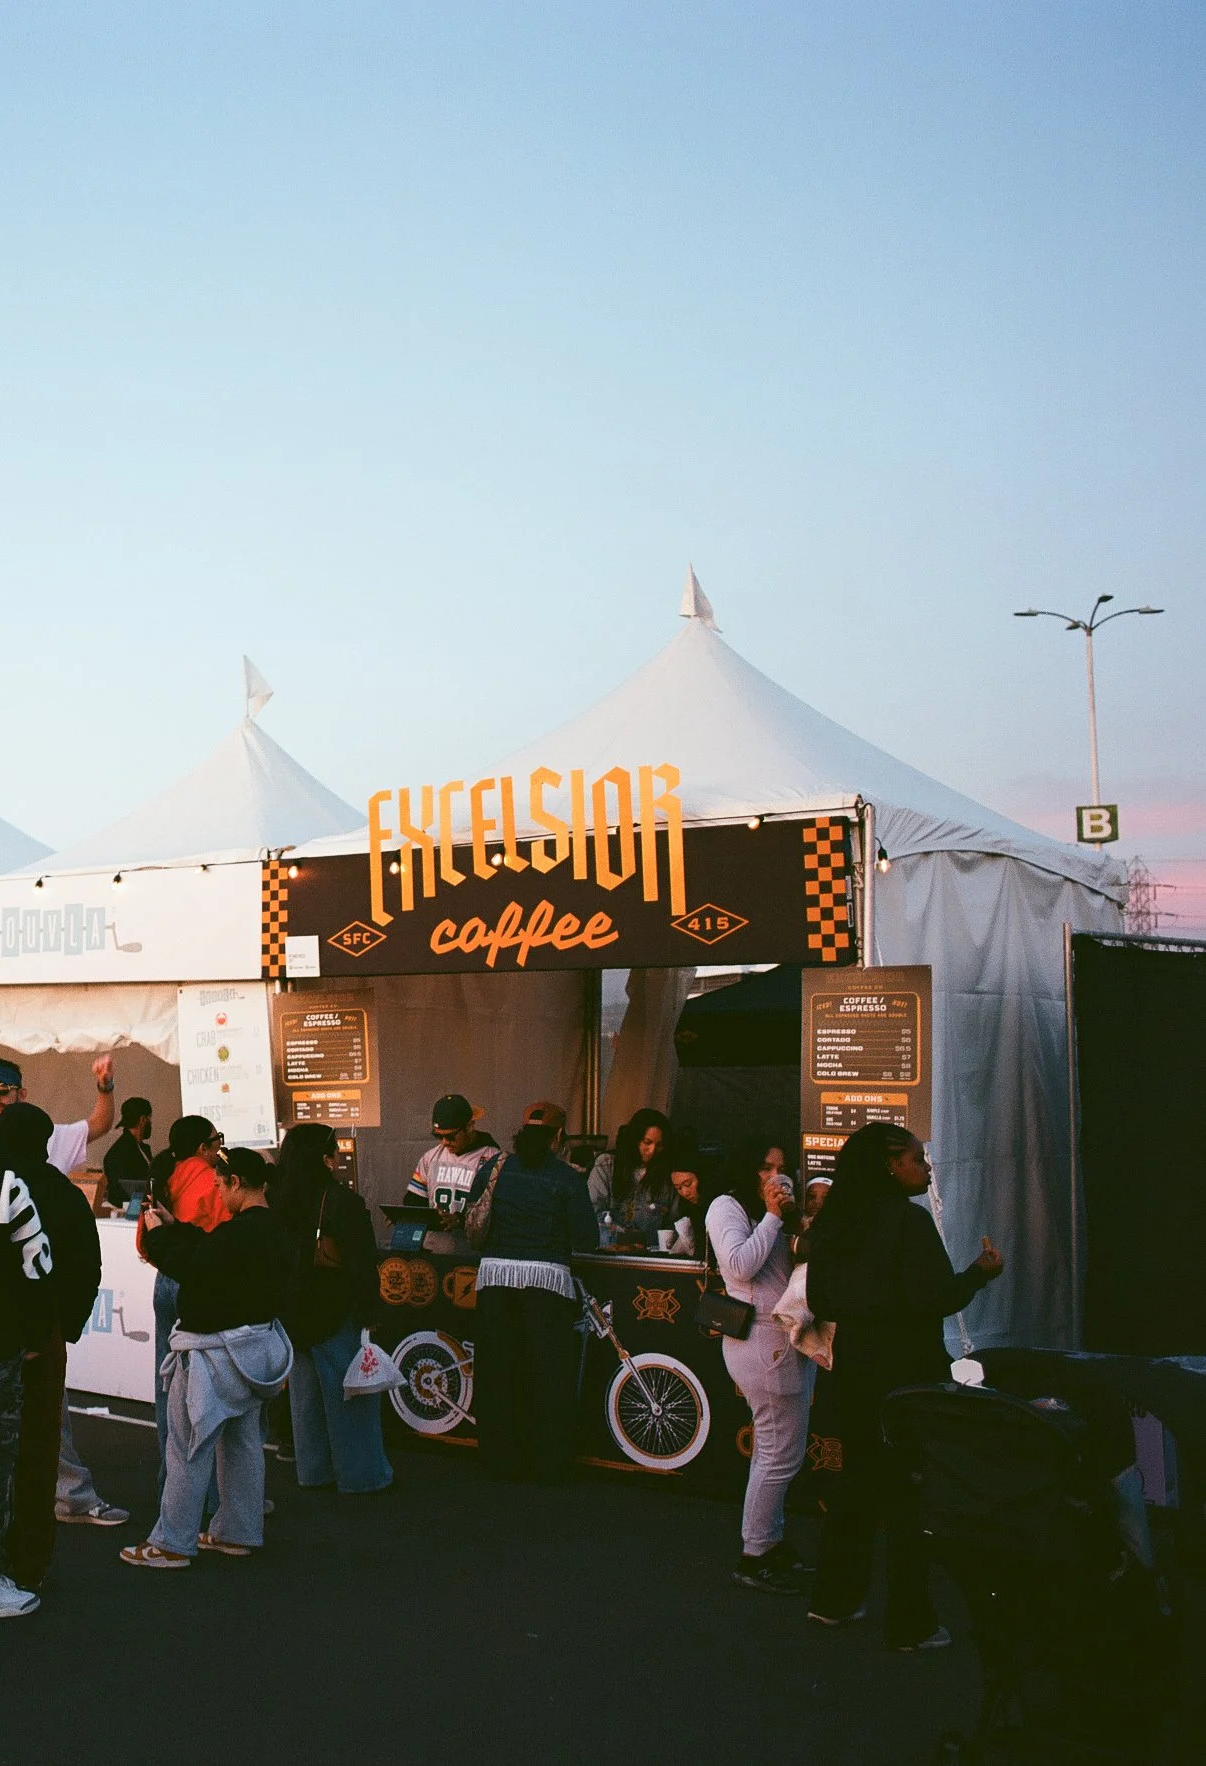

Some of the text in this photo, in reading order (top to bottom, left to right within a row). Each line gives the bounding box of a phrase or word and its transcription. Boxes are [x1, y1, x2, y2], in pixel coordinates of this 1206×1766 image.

[1082, 808, 1112, 839] B
[368, 763, 686, 927] EXCELSIOR
[687, 916, 729, 931] 415
[342, 931, 371, 946] SFC
[430, 899, 619, 968] coffee
[839, 1004, 887, 1012] ESPRESSO
[843, 997, 878, 1005] COFFEE
[303, 1019, 342, 1027] ESPRESSO
[306, 1013, 334, 1021] COFFEE
[196, 1030, 217, 1048] CRAB
[187, 1067, 220, 1086] CHICKEN
[805, 1136, 848, 1147] SPECIA
[436, 1166, 475, 1187] HAWAII
